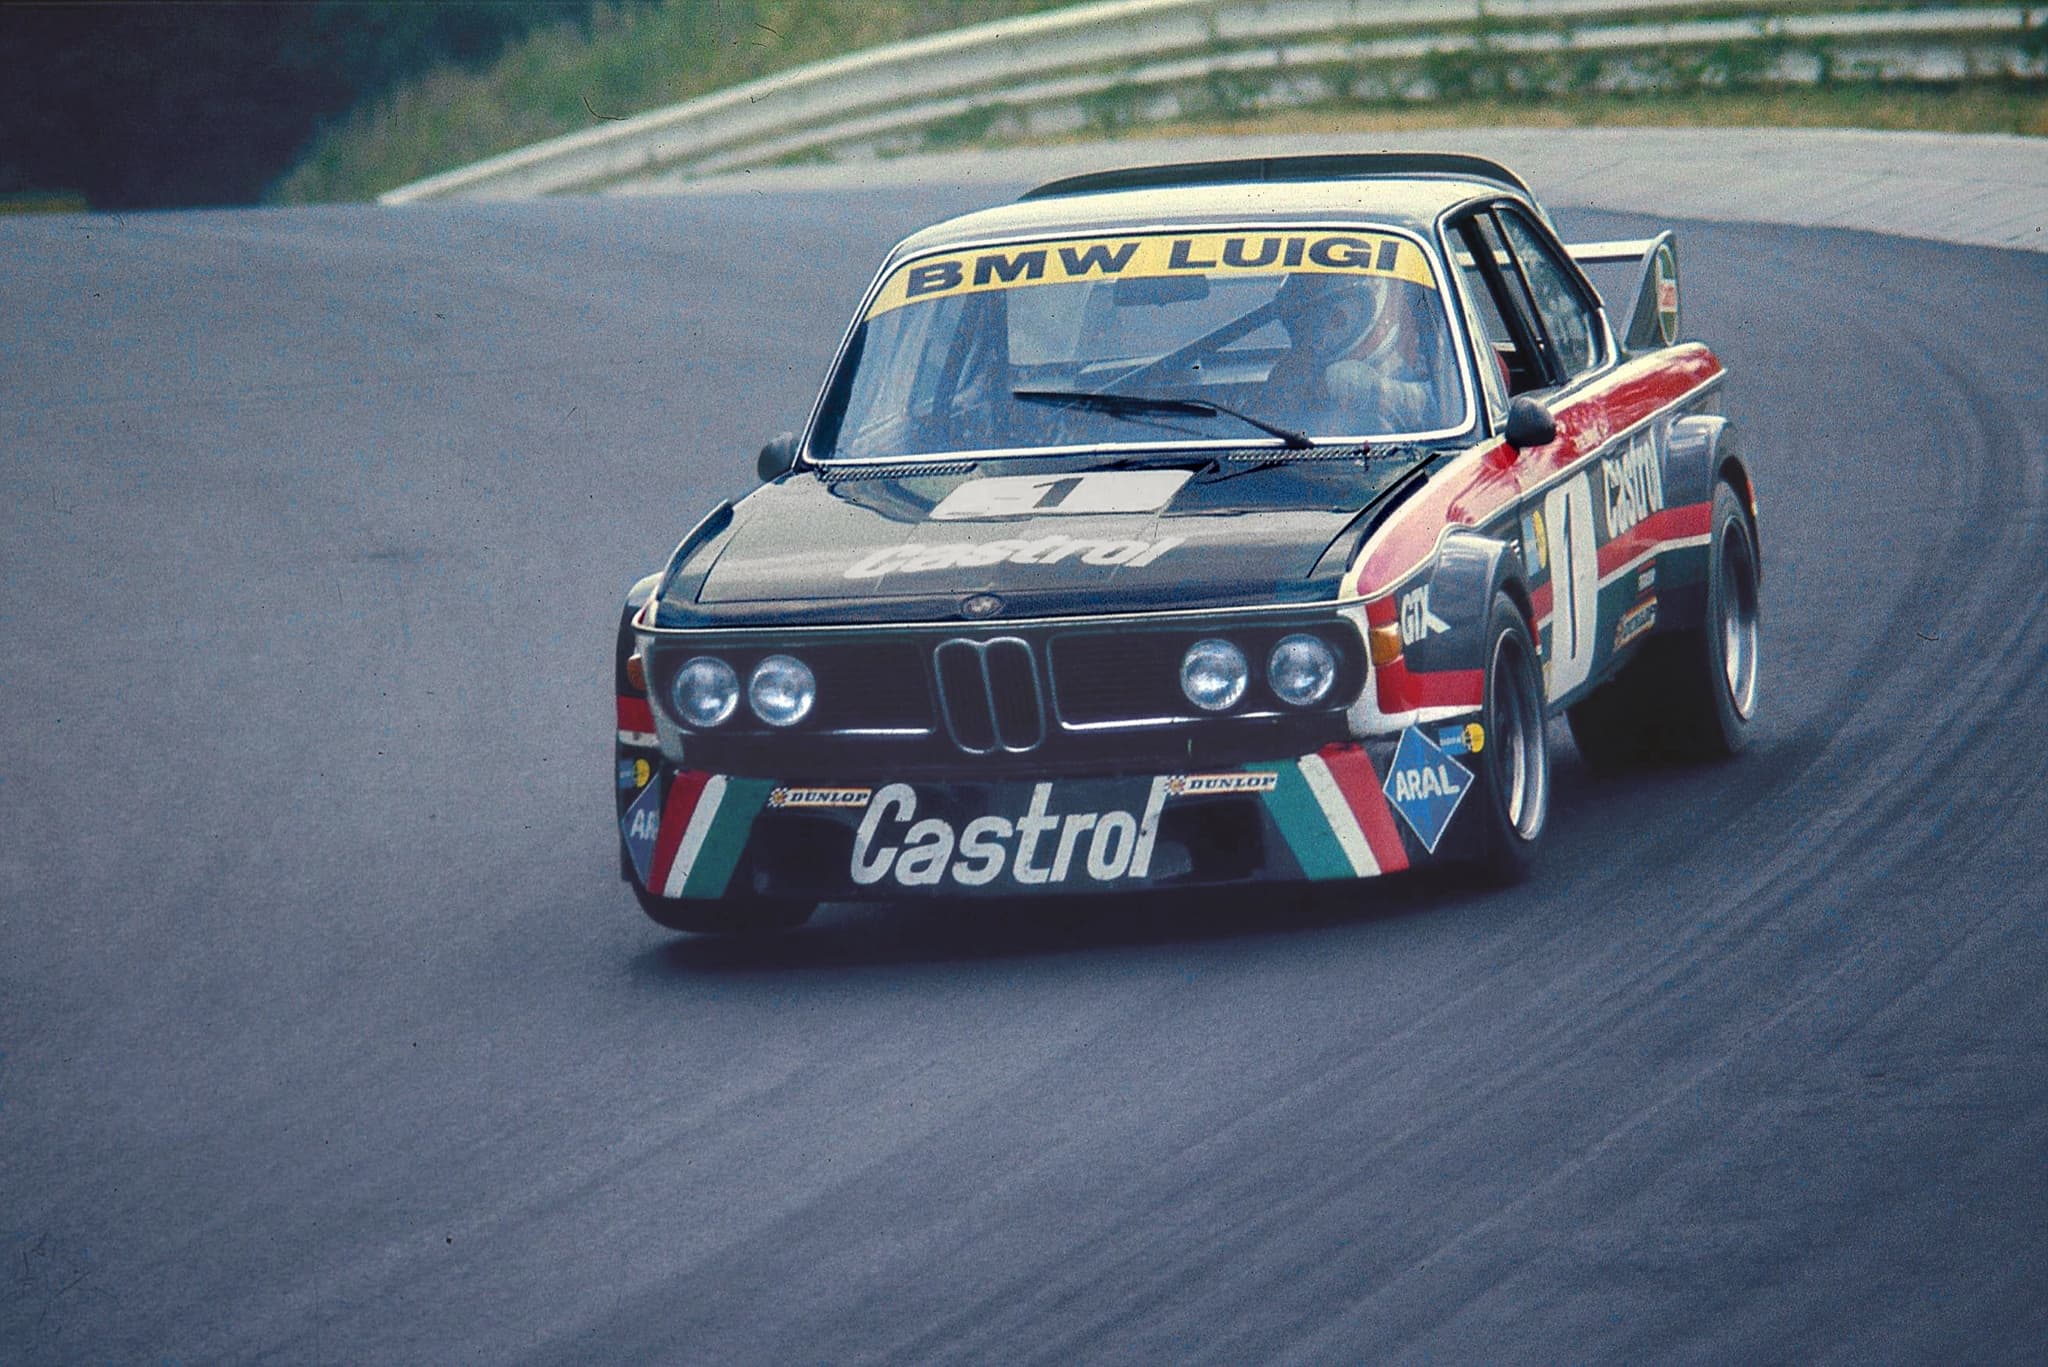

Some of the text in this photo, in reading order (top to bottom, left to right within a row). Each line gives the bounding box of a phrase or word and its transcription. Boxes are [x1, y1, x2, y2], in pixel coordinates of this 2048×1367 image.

[906, 237, 1404, 297] BMW LUIGI
[1032, 477, 1085, 509] 1
[844, 535, 1187, 580] Castrol
[1400, 583, 1451, 646] GTX
[790, 791, 869, 802] DUNLOP
[1190, 776, 1276, 789] DUNLOP
[1395, 764, 1461, 803] ARAL
[850, 774, 1169, 887] Castrol
